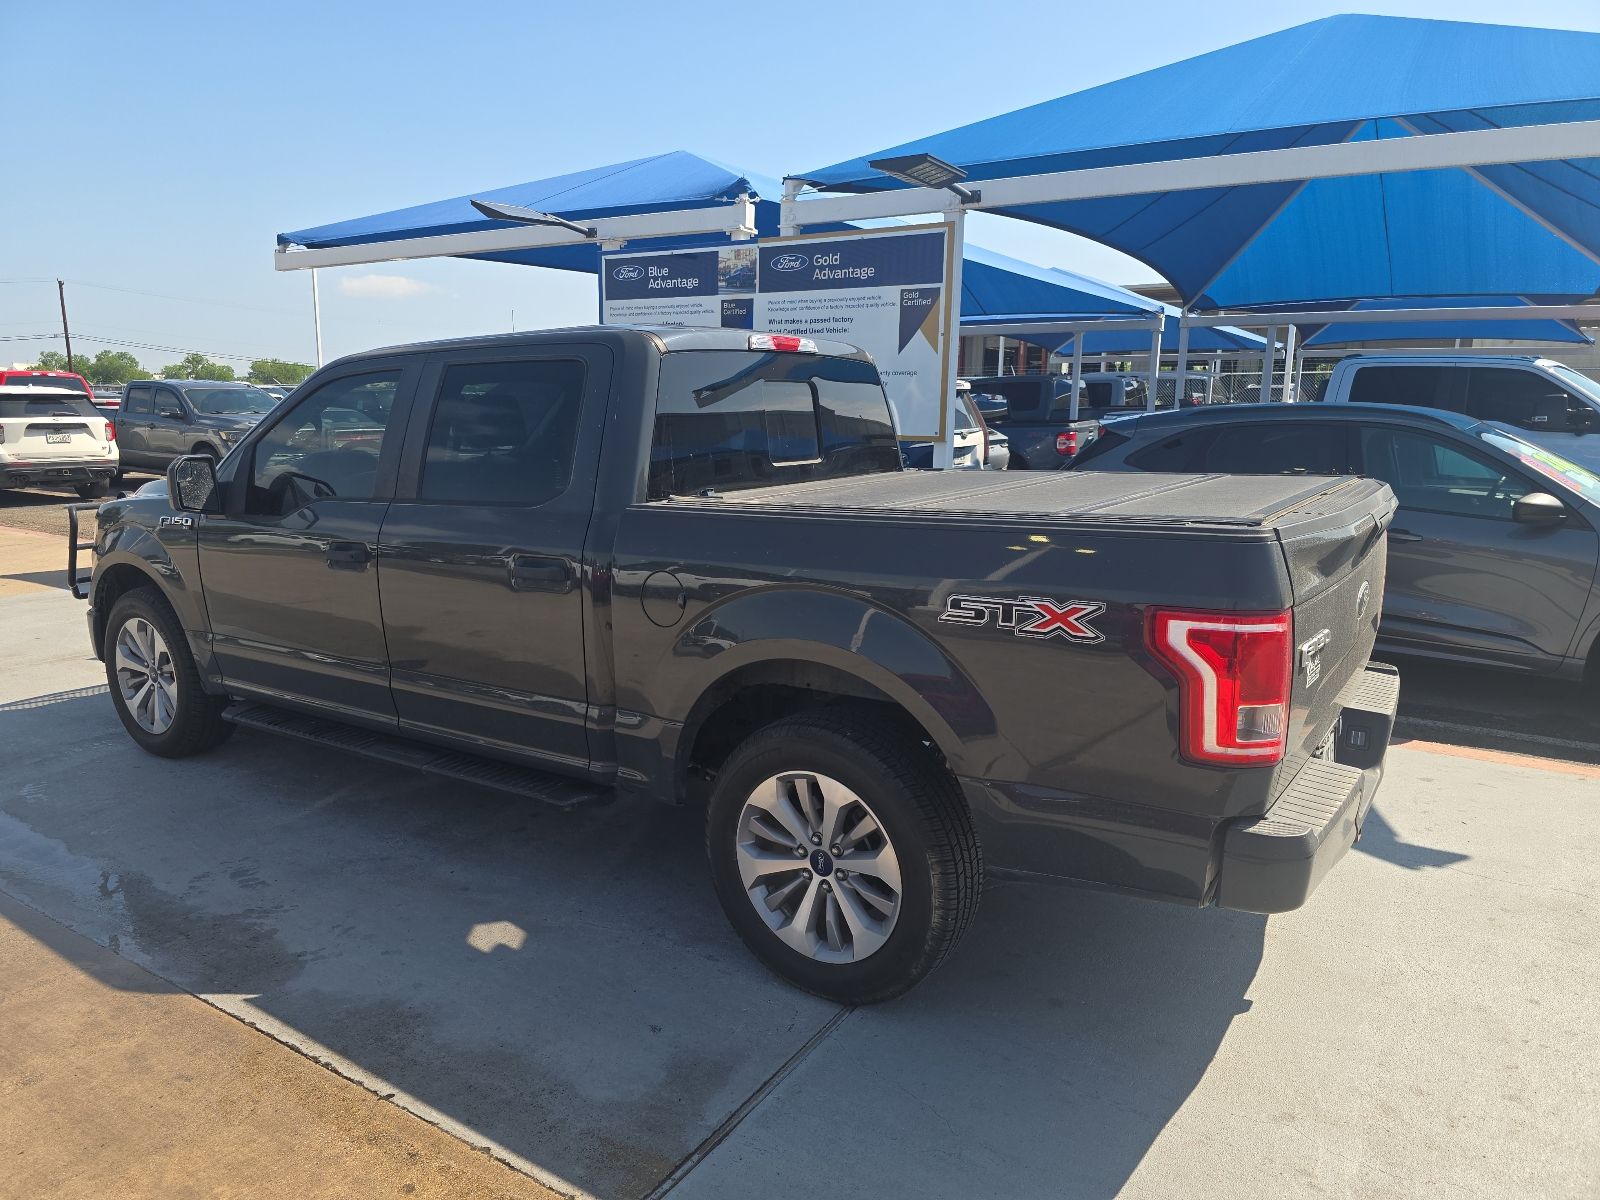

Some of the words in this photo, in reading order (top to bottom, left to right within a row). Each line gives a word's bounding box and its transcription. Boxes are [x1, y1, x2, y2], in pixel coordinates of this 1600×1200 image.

[777, 256, 801, 269] Ford
[813, 253, 840, 266] Gold
[618, 266, 639, 279] Ford
[648, 266, 669, 277] Blue
[813, 266, 875, 281] Advantage
[648, 277, 699, 289] Advantage
[903, 291, 919, 299] Gold
[902, 298, 932, 306] Certified
[784, 317, 802, 325] makes
[809, 317, 831, 325] passed
[832, 316, 854, 324] factory
[938, 594, 1106, 644] STX
